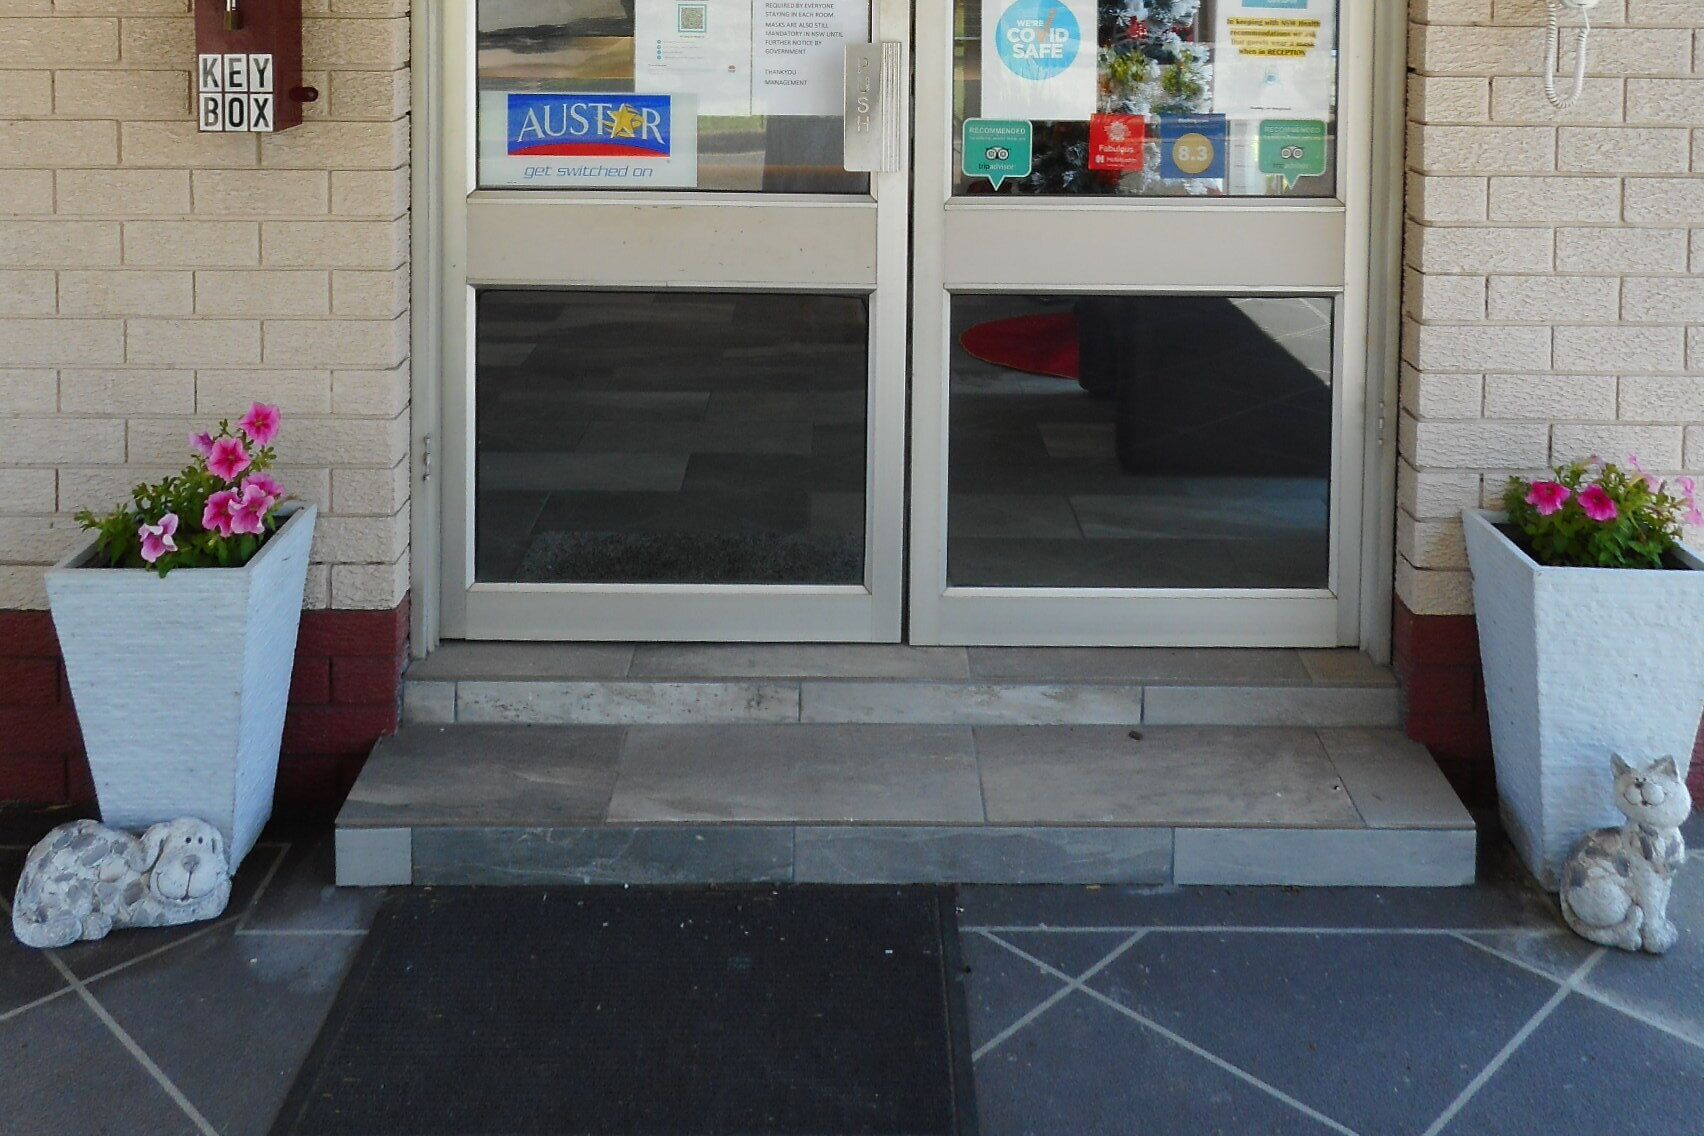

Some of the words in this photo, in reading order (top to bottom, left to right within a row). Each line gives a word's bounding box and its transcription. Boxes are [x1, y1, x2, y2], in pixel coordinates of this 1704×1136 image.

[1013, 44, 1063, 58] SAFE
[202, 57, 270, 88] KEY
[203, 97, 269, 127] BOX
[1099, 145, 1134, 153] Fabulous
[1179, 146, 1208, 160] 8.3
[524, 166, 552, 178] get
[556, 166, 628, 177] switched
[632, 167, 653, 177] on
